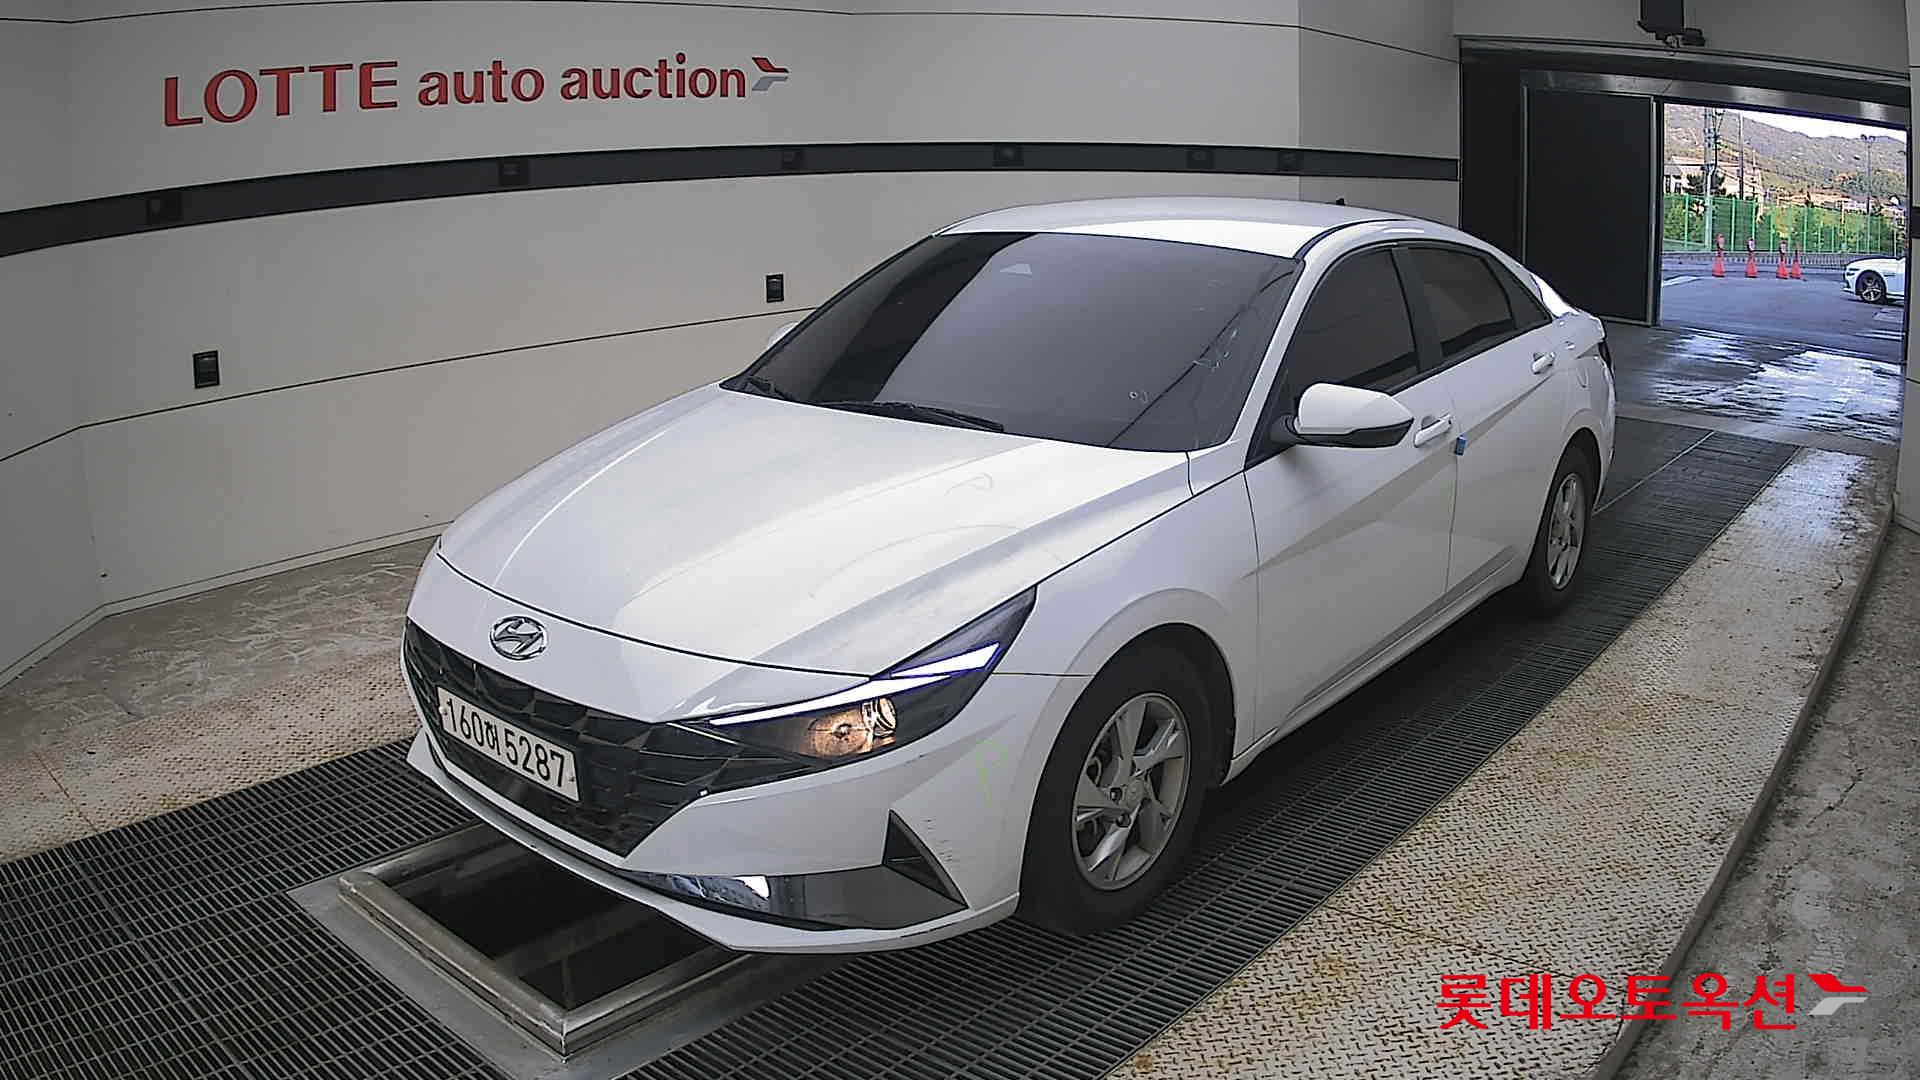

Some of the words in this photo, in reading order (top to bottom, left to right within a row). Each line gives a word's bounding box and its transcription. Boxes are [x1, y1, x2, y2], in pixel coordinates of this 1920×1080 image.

[164, 61, 398, 126] LOTTE
[418, 59, 545, 106] auto
[561, 53, 746, 101] auction
